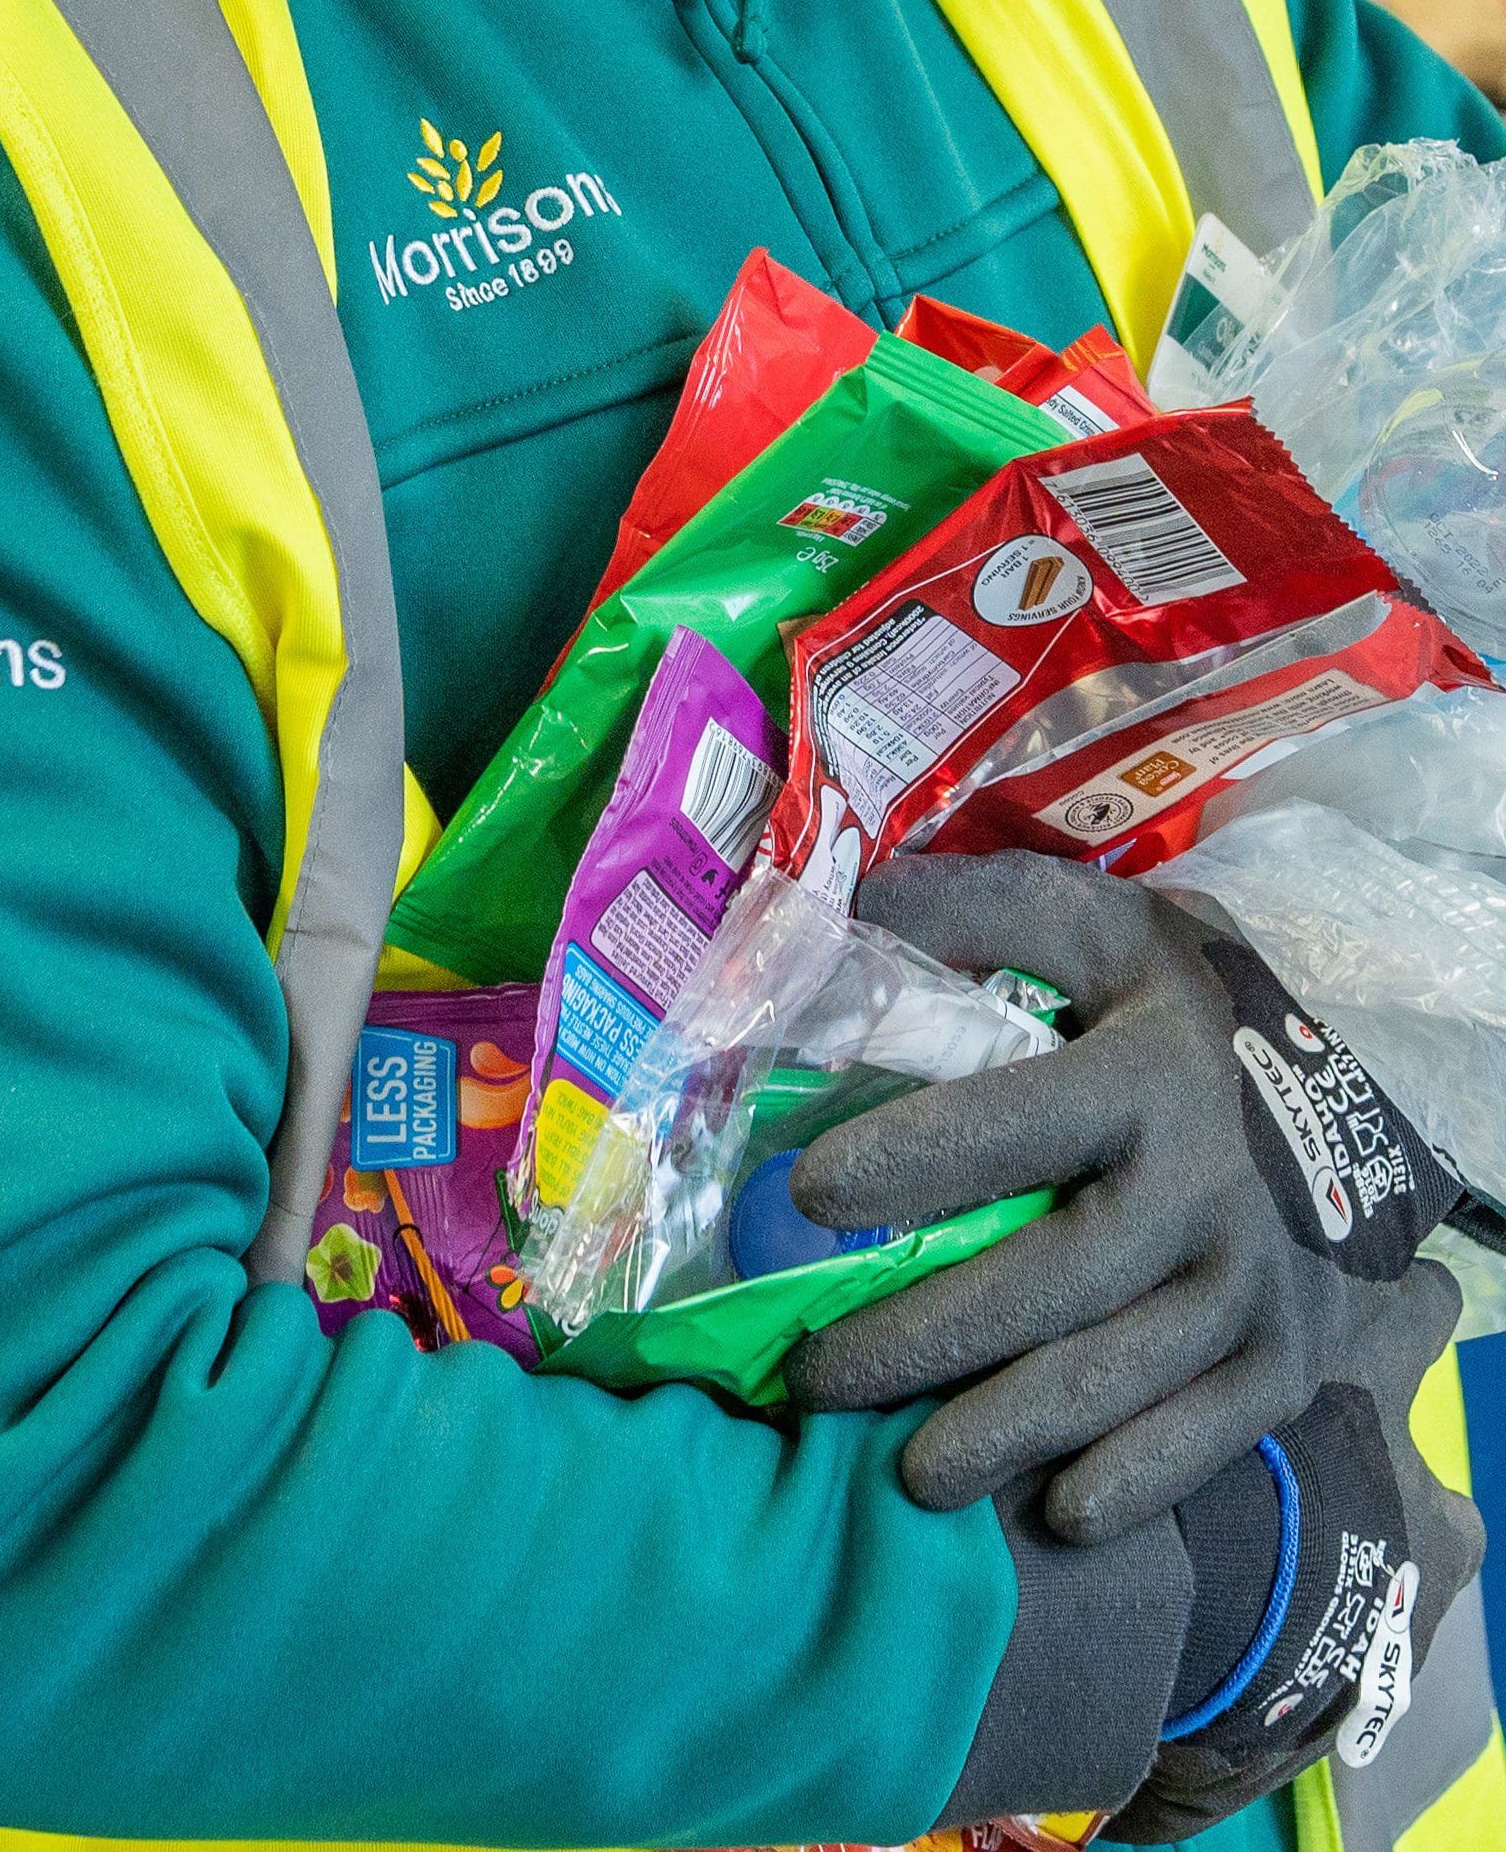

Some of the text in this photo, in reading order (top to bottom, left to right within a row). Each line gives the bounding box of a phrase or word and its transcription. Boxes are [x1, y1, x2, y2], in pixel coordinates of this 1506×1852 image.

[446, 239, 574, 311] Since 1899
[1057, 404, 1082, 426] Salted
[1056, 491, 1097, 544] 613036
[809, 547, 839, 575] 25g
[1427, 511, 1454, 541] OCT
[1454, 543, 1489, 578] 2022
[981, 551, 1021, 585] SERVING
[1001, 561, 1022, 578] BAR
[1007, 605, 1057, 620] SERVINGS
[946, 672, 994, 716] Typical values
[1305, 676, 1334, 695] Learn
[874, 730, 903, 758] 104kcal
[897, 748, 912, 762] bar
[903, 753, 919, 768] Per
[1136, 756, 1180, 787] Cocoa
[587, 1032, 615, 1059] THESE
[366, 1053, 408, 1146] LESS
[413, 1038, 438, 1161] PACKAGING
[1251, 1046, 1324, 1164] SKYTEC
[1386, 1142, 1407, 1197] 3131X
[1332, 1530, 1353, 1596] GLOBUS
[1355, 1640, 1402, 1750] SKYTEC
